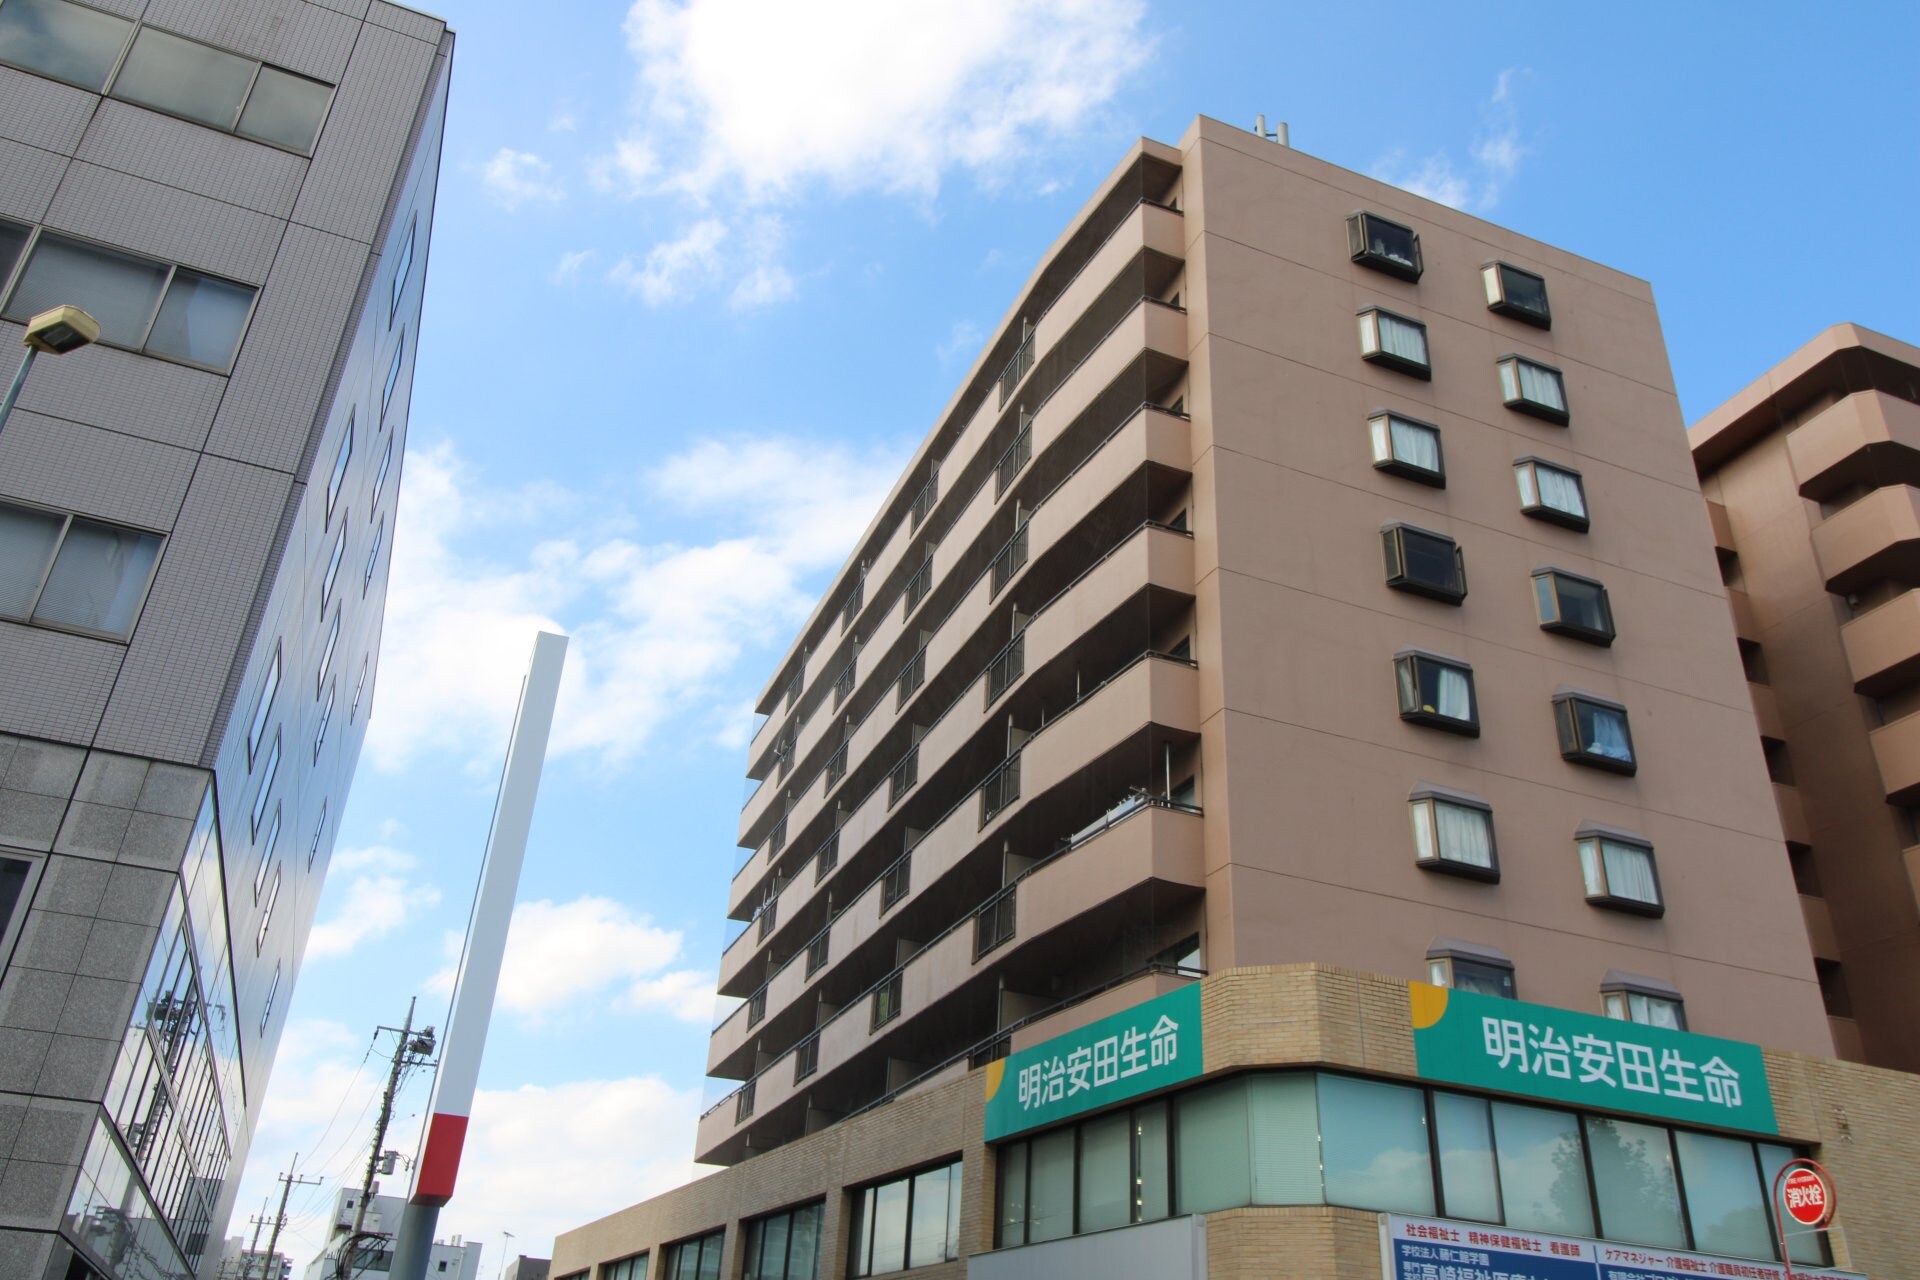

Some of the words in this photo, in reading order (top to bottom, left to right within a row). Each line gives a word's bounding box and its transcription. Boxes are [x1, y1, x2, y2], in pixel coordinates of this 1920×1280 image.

[1018, 1014, 1179, 1111] 明治安田生命
[1482, 1016, 1742, 1108] 明治安田生命
[1786, 1184, 1823, 1208] 消火栓
[1405, 1223, 1461, 1242] 社会福祉士
[1468, 1231, 1542, 1252] 精神保健福祉士
[1550, 1241, 1581, 1257] 看護師
[1605, 1249, 1664, 1266] ケアマネジャー
[1666, 1256, 1707, 1274] 介護福祉士
